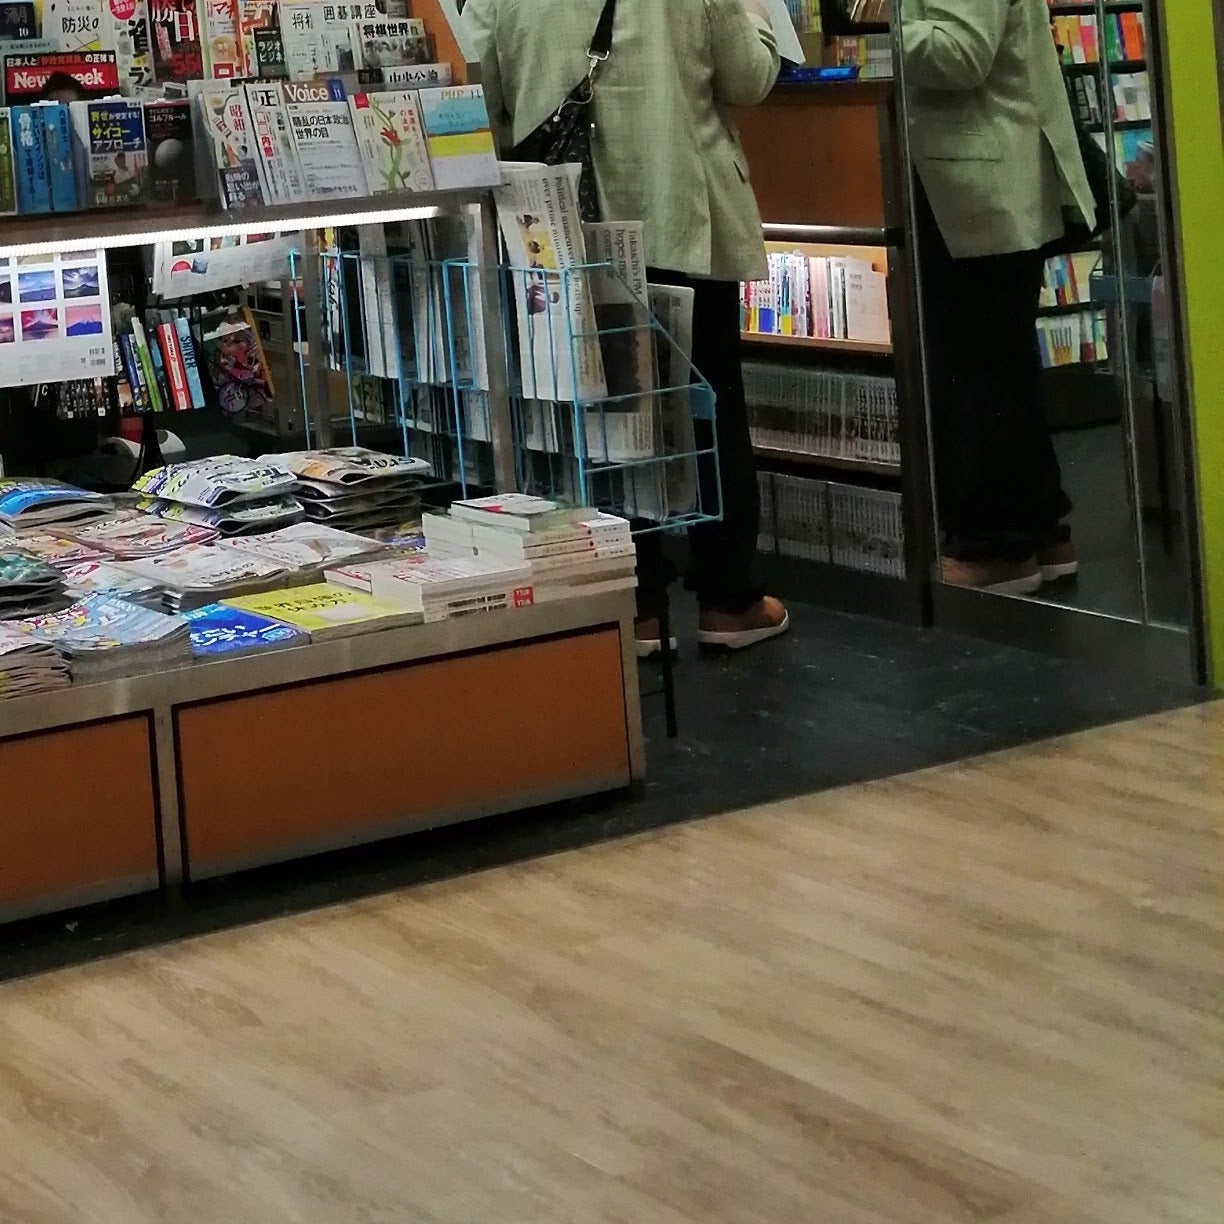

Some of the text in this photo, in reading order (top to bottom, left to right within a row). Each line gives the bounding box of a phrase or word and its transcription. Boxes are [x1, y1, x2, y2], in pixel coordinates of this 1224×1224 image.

[18, 27, 29, 36] 10
[362, 22, 409, 38] 将棋世界
[284, 83, 329, 102] Voice
[440, 89, 465, 101] PHP
[541, 177, 552, 198] over
[555, 175, 570, 214] Political
[543, 198, 556, 227] prime
[615, 229, 628, 259] hopes
[632, 278, 643, 296] PM
